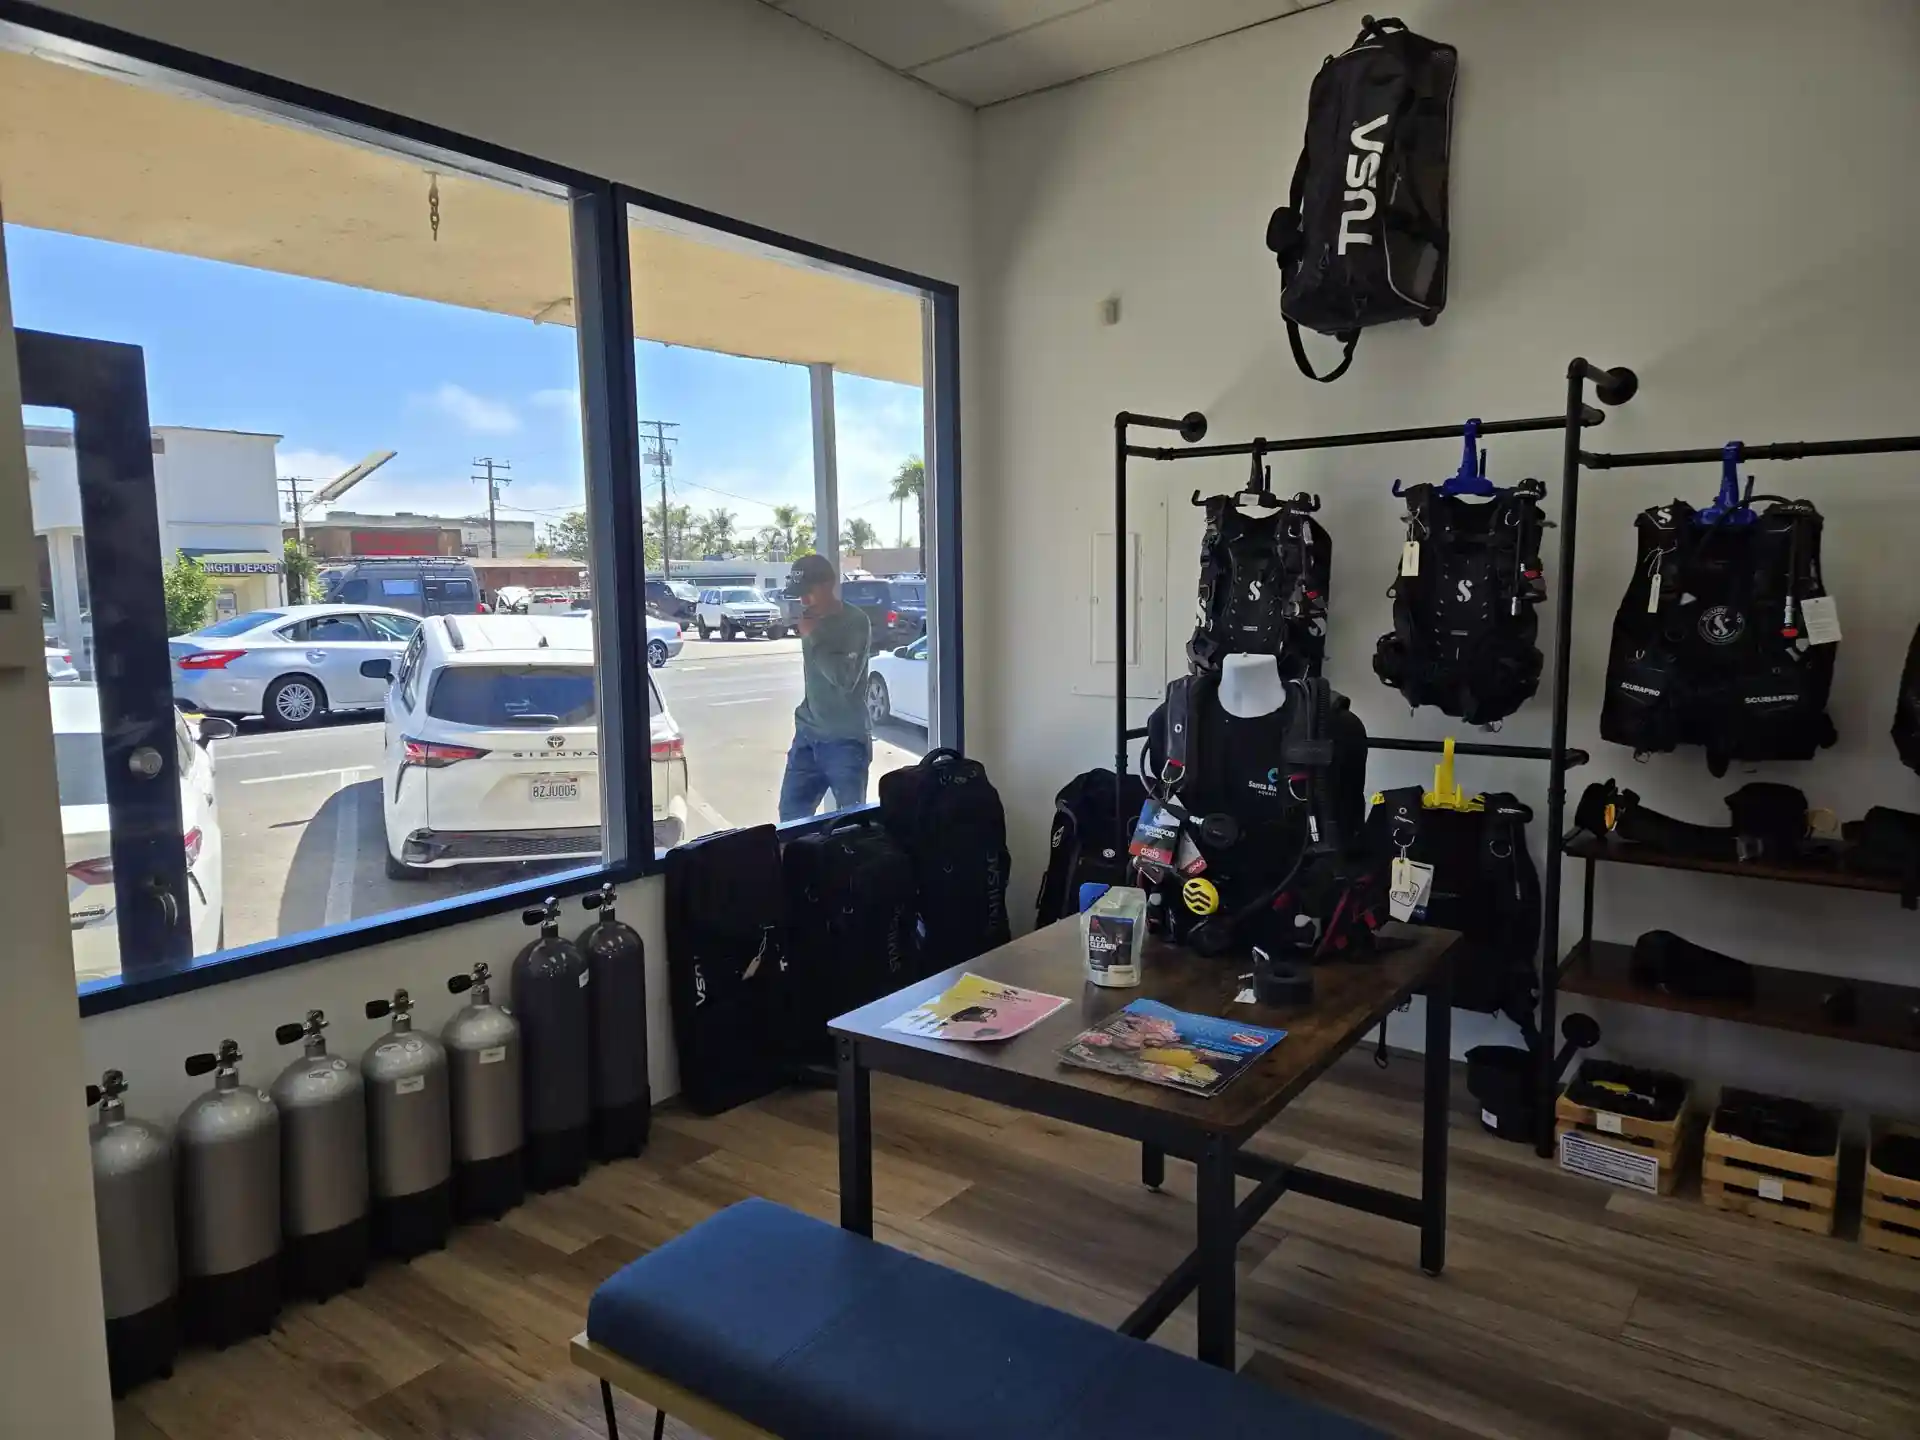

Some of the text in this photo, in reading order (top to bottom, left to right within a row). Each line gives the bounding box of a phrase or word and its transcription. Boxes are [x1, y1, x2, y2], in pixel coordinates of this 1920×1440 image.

[1337, 113, 1390, 256] TUSA
[203, 562, 278, 574] NIGHT DEPOSI
[1620, 681, 1661, 697] SCUBAPRO
[1743, 693, 1800, 704] SCUBAPRO
[512, 750, 598, 759] SIENNA
